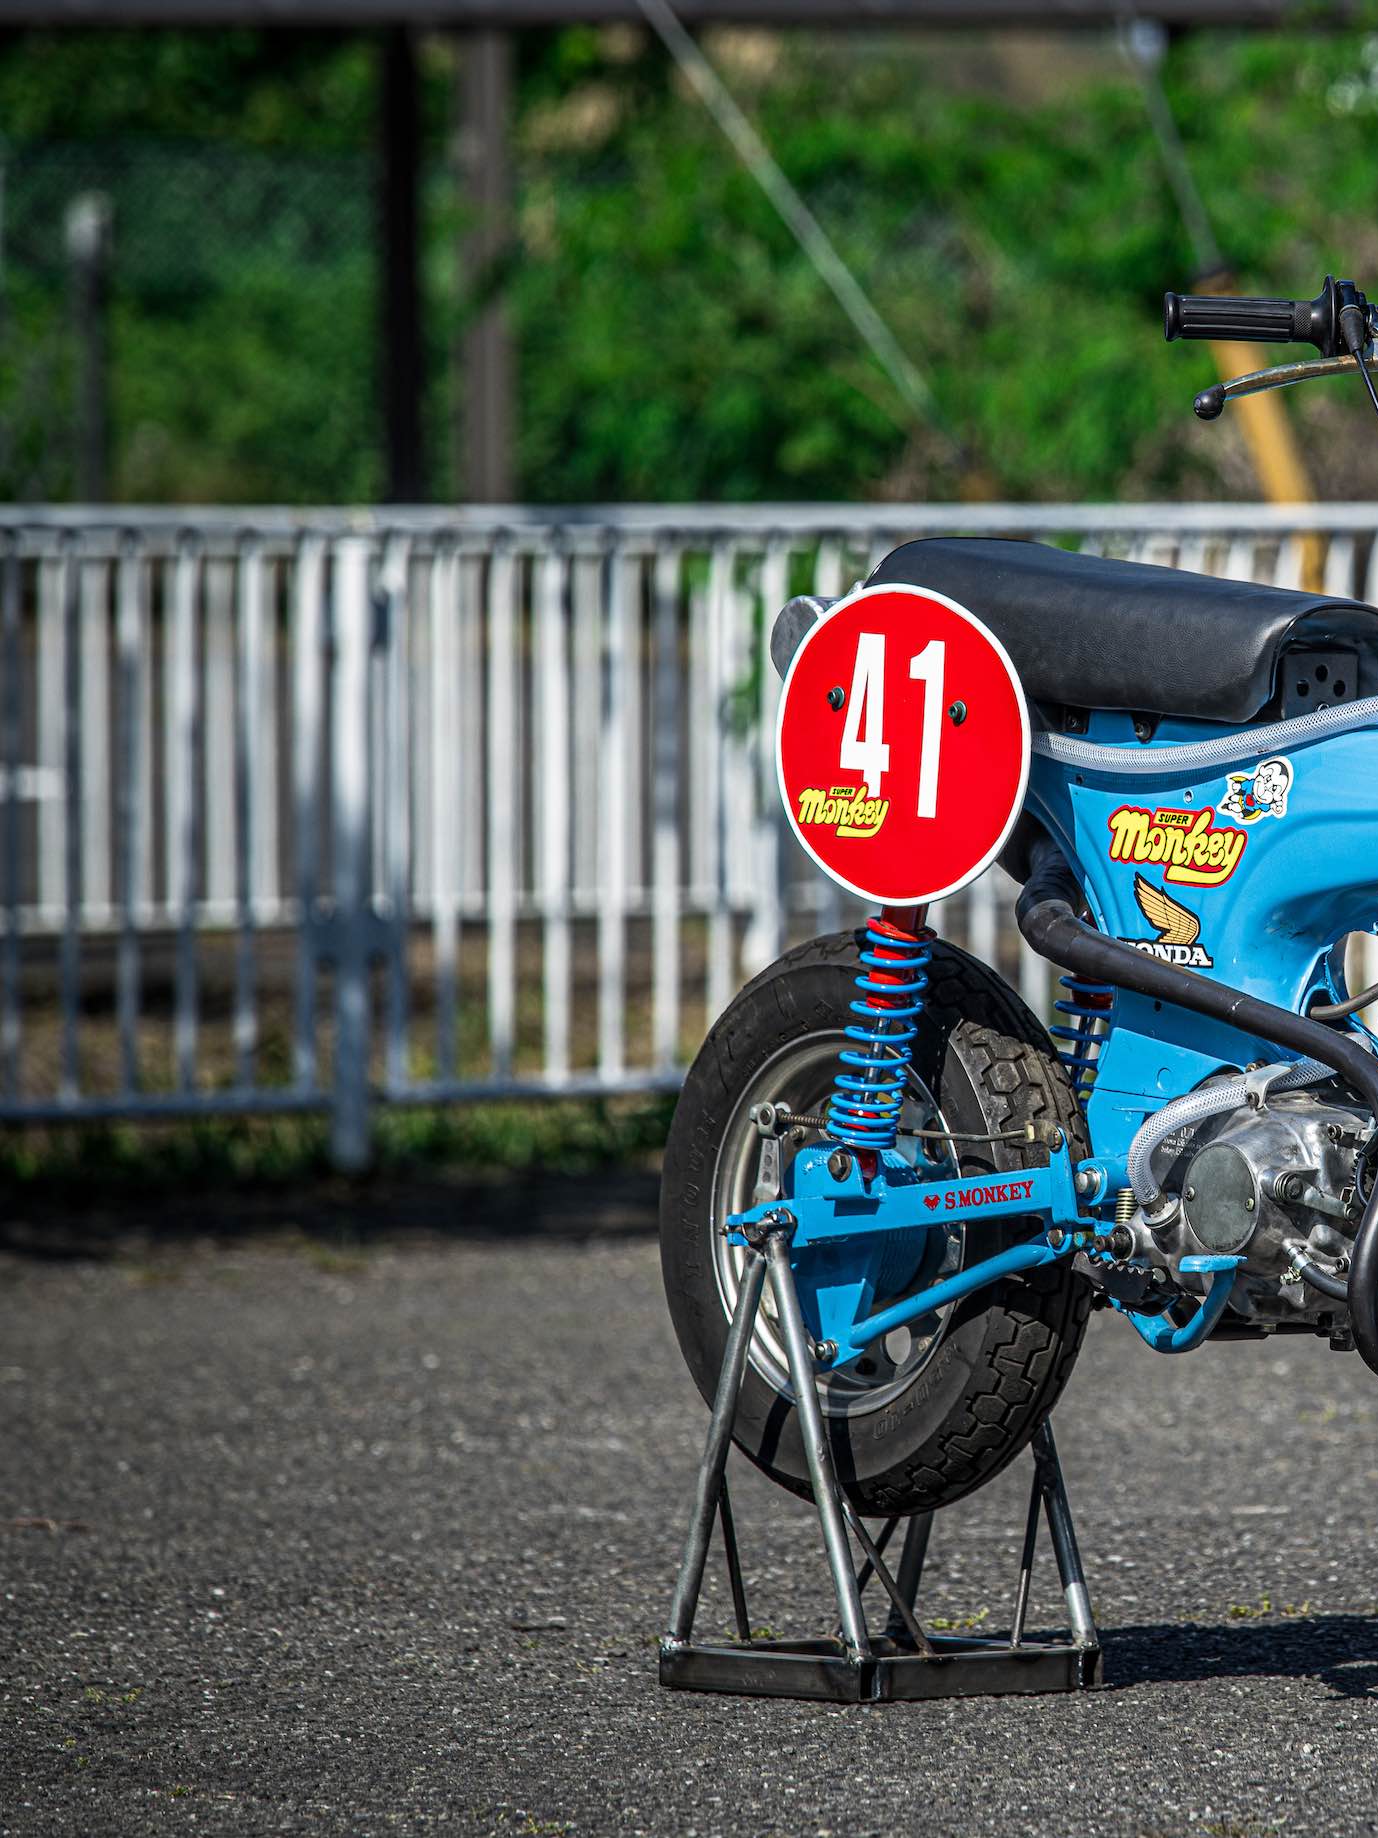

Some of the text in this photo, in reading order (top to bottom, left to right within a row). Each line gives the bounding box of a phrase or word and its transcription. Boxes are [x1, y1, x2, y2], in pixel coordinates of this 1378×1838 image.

[840, 632, 946, 818] 41
[832, 788, 853, 796] SUPER
[1158, 813, 1190, 825] SUPER
[1125, 942, 1212, 966] ONDA
[945, 1180, 1034, 1210] S.MONKEY
